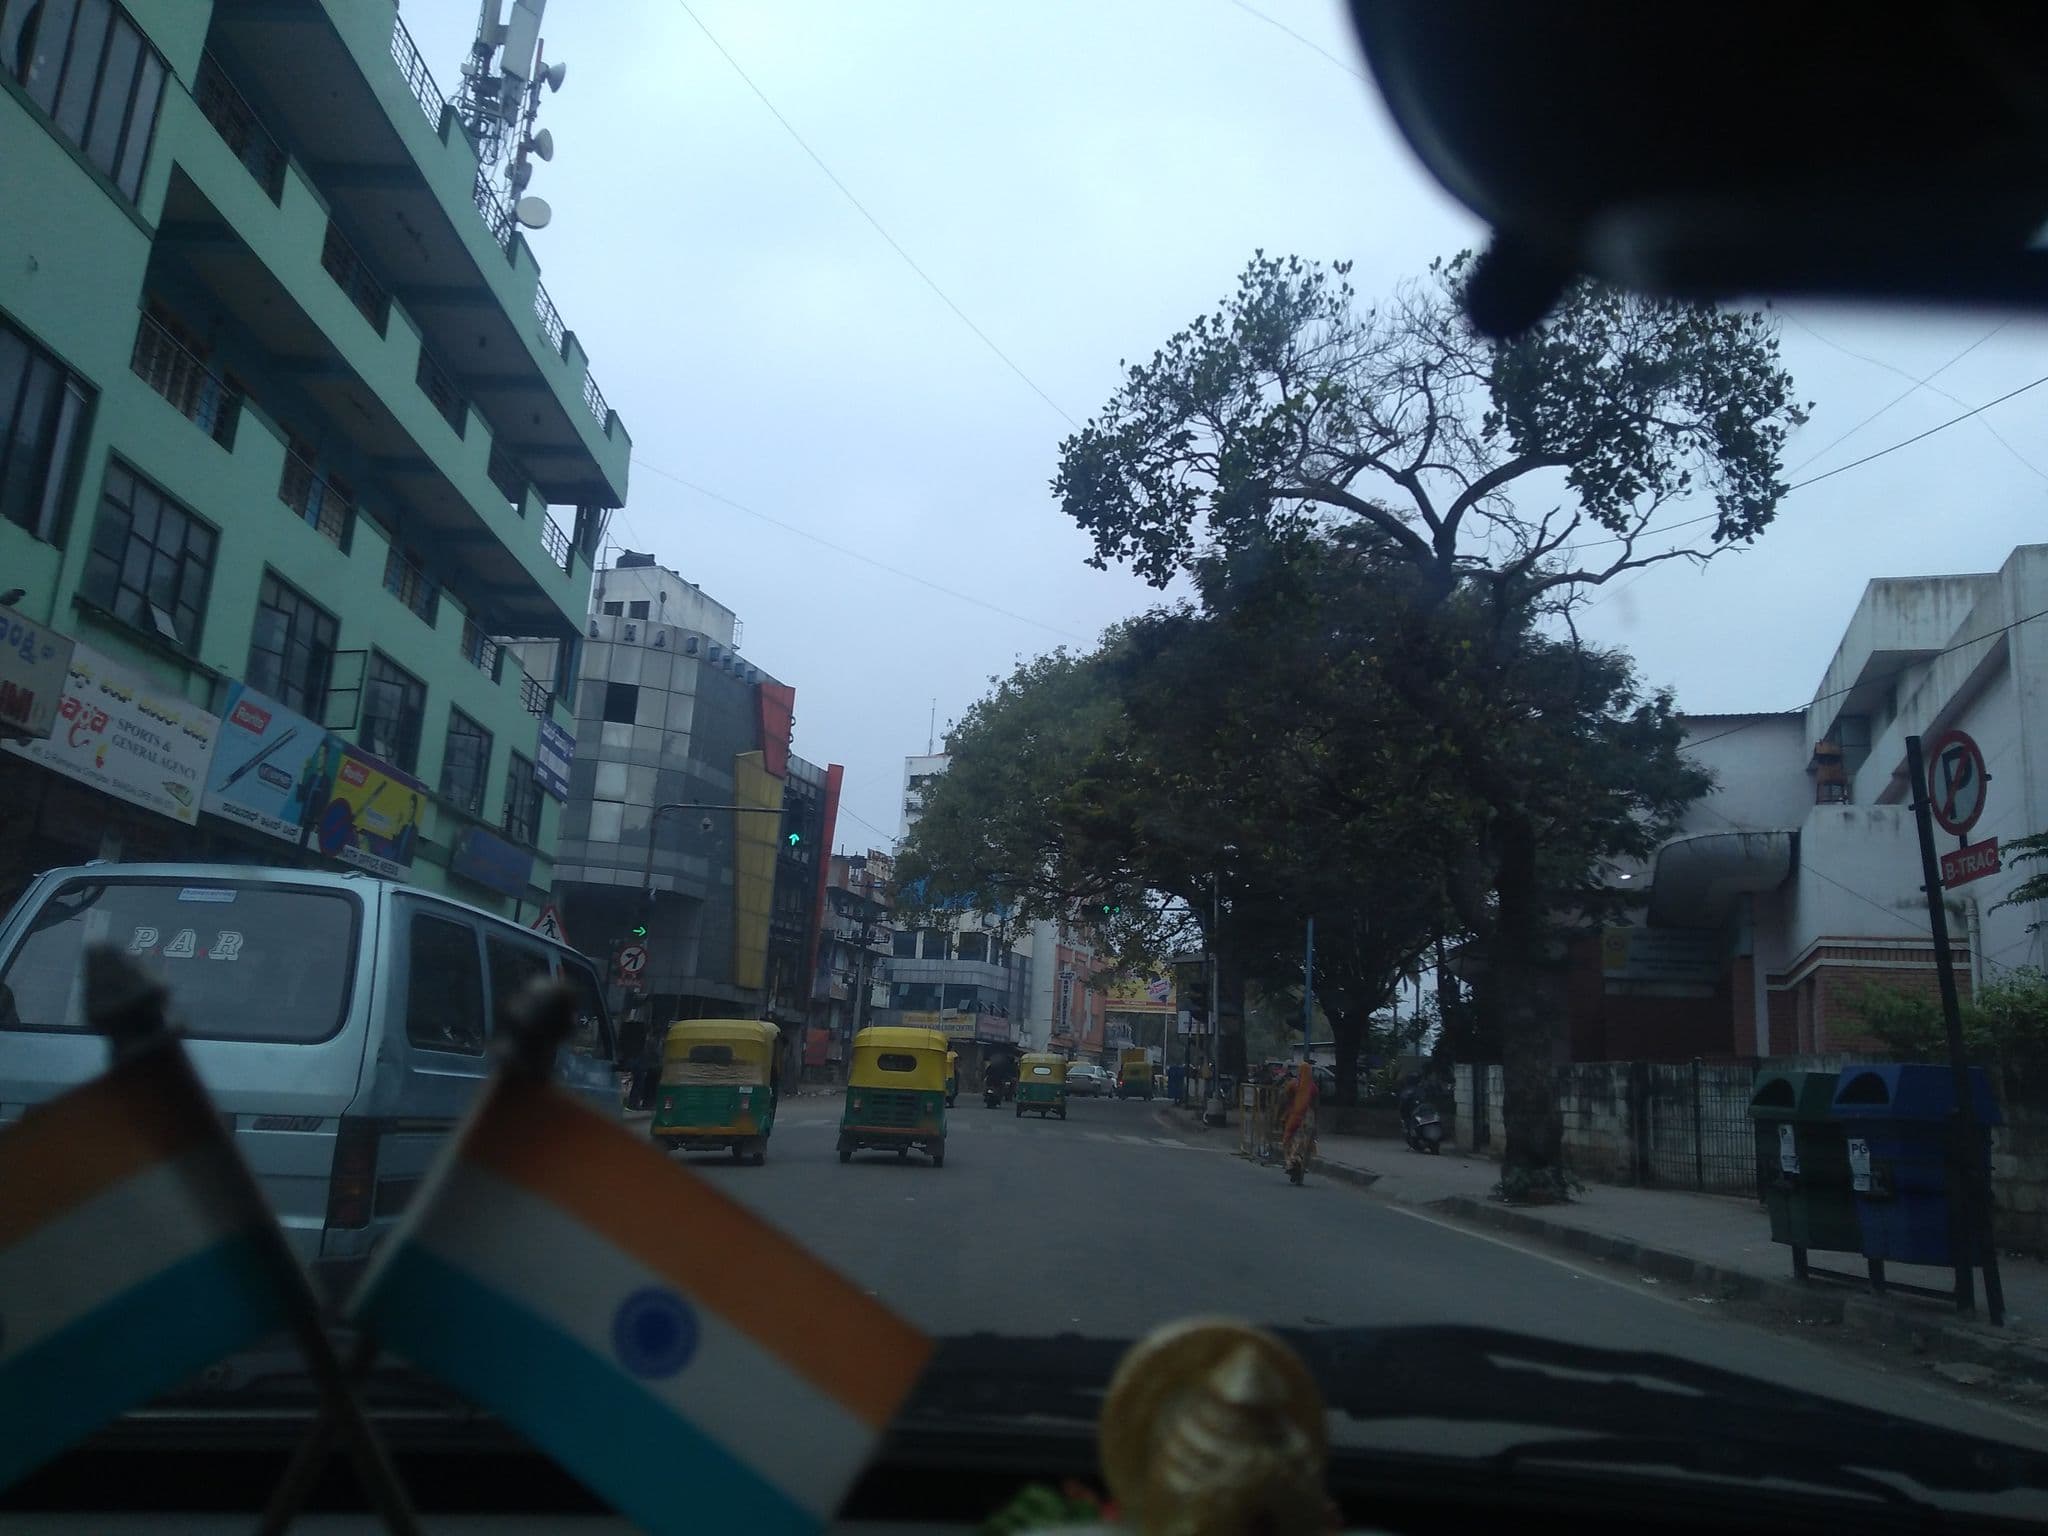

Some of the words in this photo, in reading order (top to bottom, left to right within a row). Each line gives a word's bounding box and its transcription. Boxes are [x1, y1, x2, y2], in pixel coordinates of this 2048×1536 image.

[111, 734, 159, 762] GENERAL
[116, 718, 160, 746] SPORTS
[162, 741, 171, 752] &
[1945, 848, 1996, 881] B-TRAC
